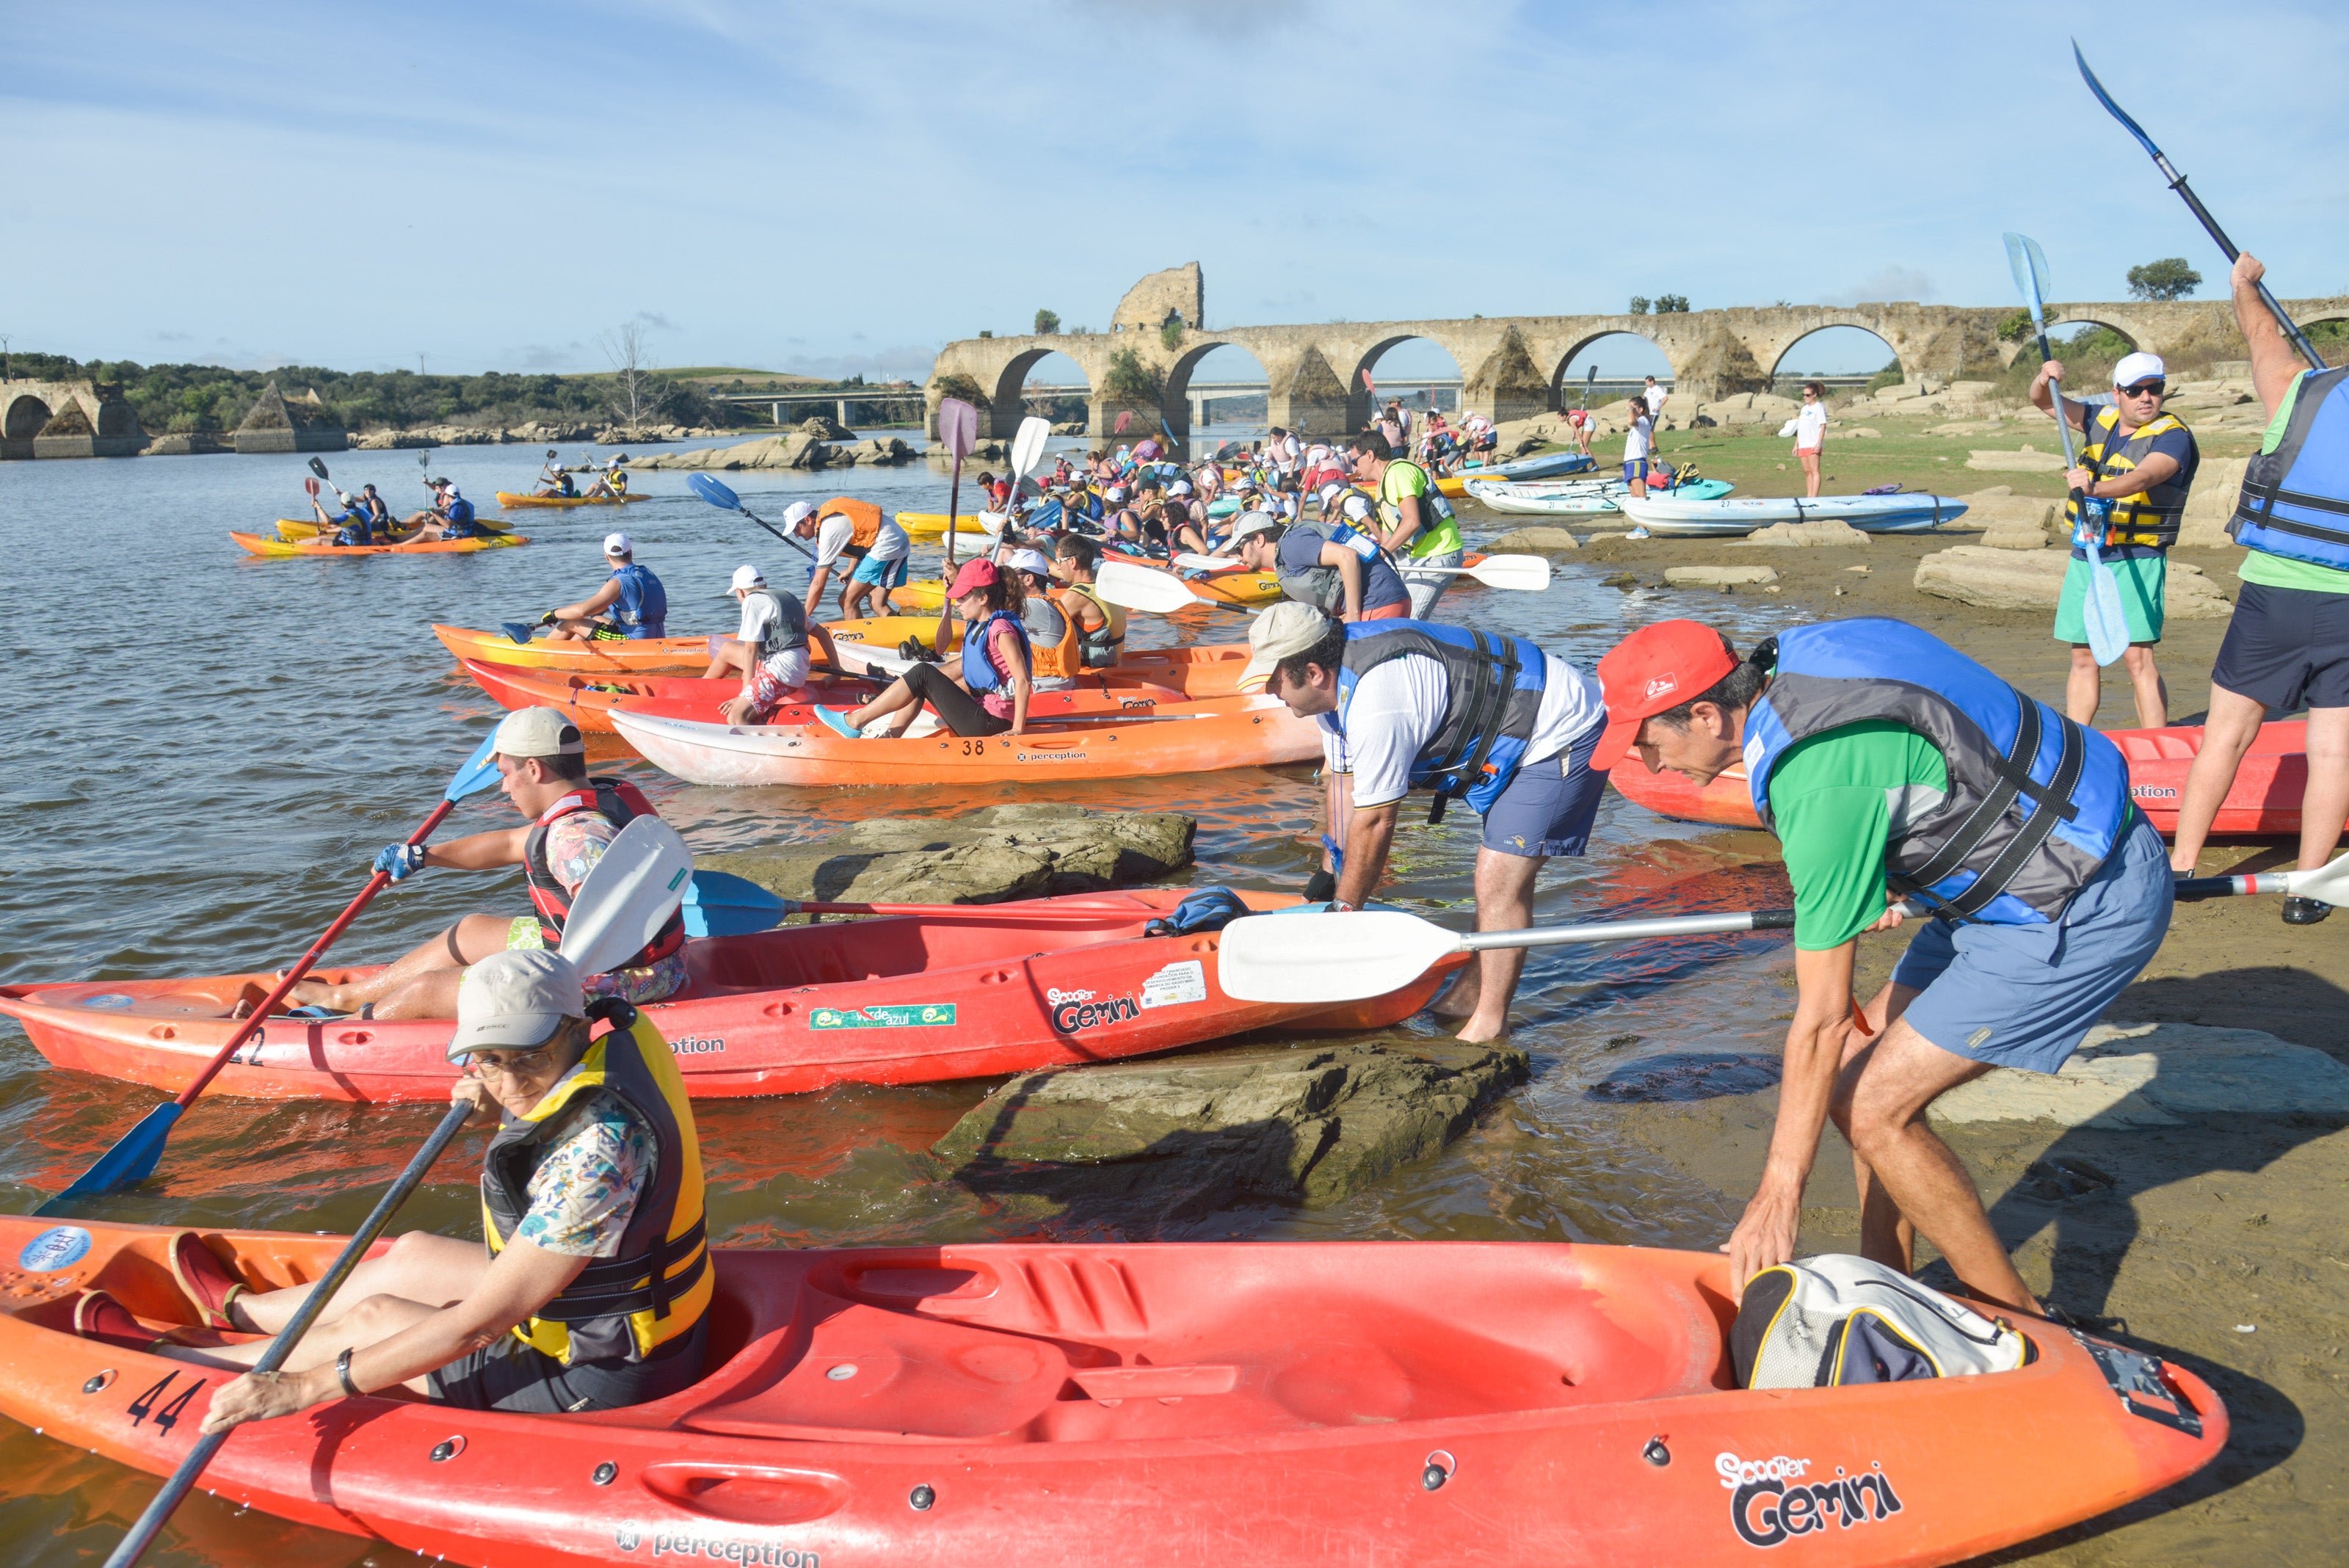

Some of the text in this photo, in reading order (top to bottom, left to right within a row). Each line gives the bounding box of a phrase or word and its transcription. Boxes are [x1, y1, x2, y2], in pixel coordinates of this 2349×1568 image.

[962, 740, 984, 756] 38
[1031, 752, 1086, 761] perception
[885, 1012, 909, 1026] azul
[1052, 991, 1141, 1035] Gemini
[127, 1369, 208, 1437] 44
[1730, 1460, 1904, 1549] Gemini
[654, 1531, 821, 1568] perception
